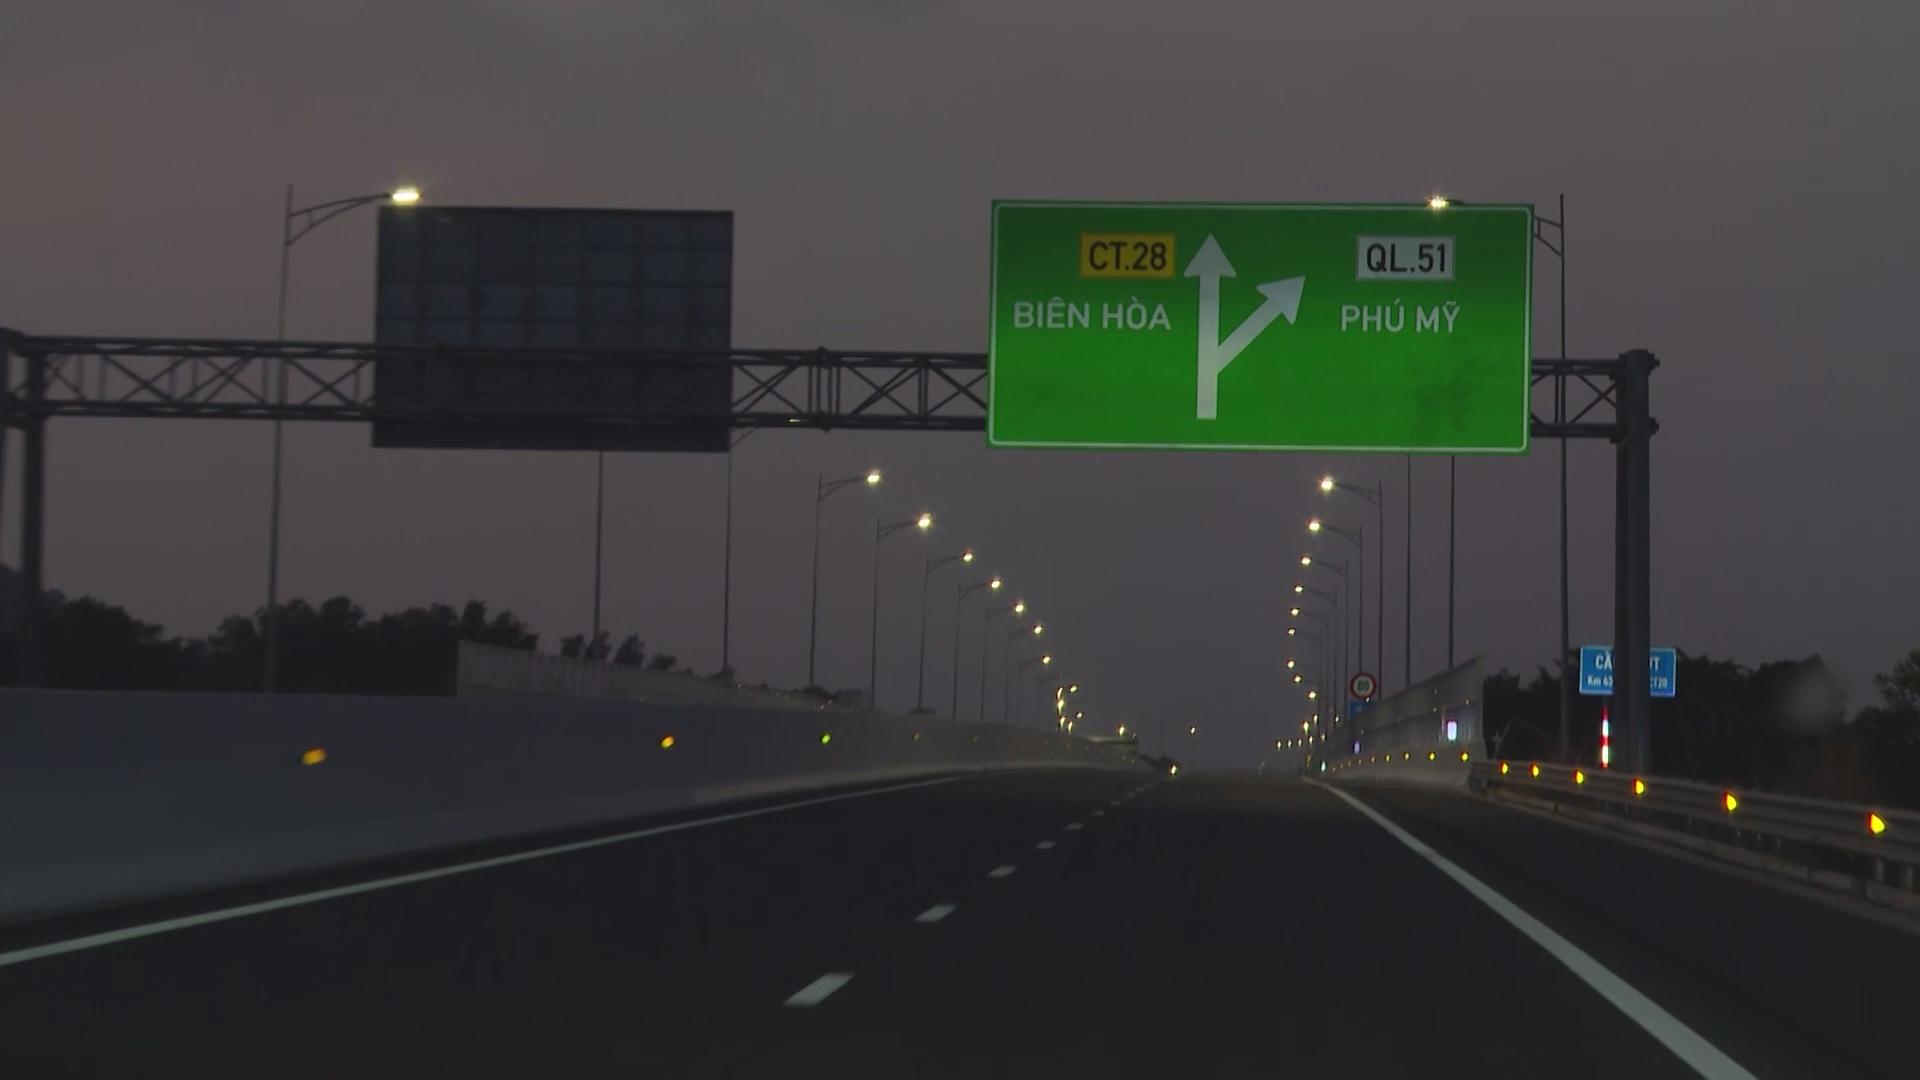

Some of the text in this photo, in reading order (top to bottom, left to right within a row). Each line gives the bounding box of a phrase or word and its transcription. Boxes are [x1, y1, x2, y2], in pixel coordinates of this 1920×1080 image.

[1089, 241, 1167, 271] CT.28
[1366, 243, 1446, 273] QL.51
[1013, 296, 1172, 331] BIÊN HÒA
[1341, 297, 1461, 334] PHÚ MỸ
